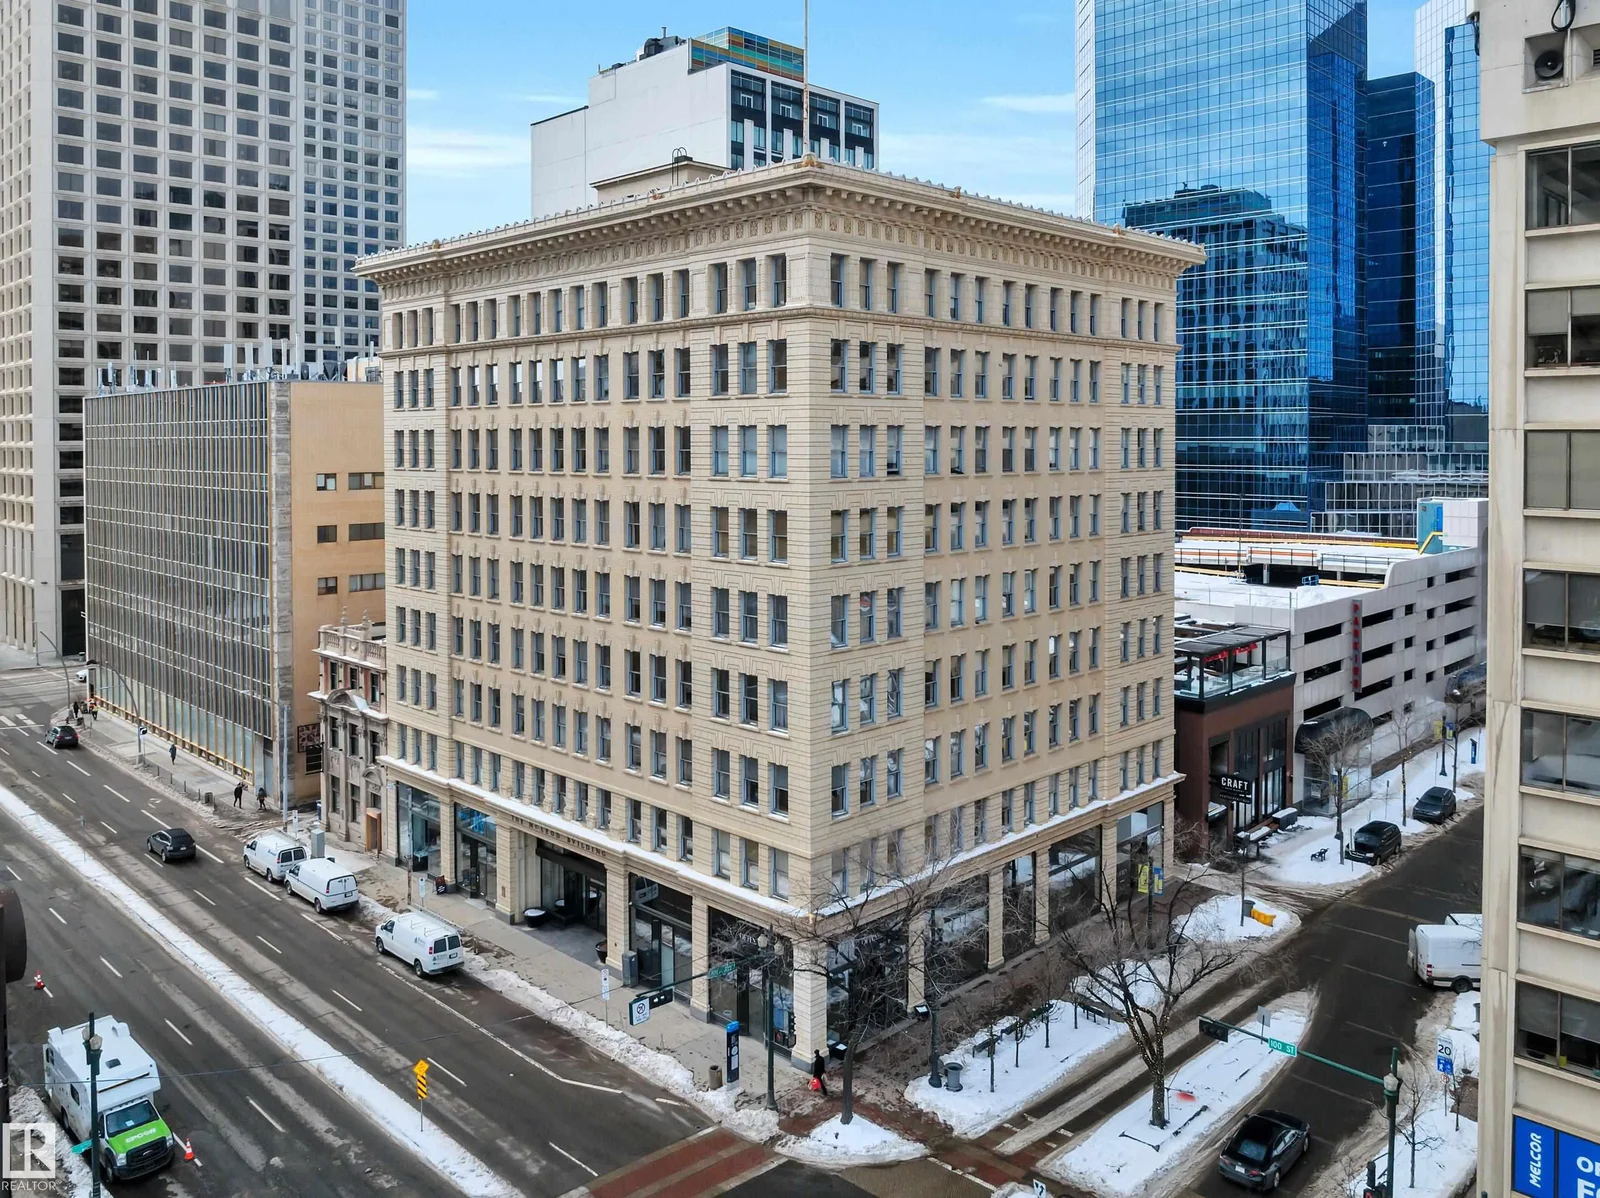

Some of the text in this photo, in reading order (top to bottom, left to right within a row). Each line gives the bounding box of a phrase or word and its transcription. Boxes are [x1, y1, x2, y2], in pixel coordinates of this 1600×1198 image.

[1221, 777, 1249, 790] CRAFT
[511, 814, 524, 825] THE
[1270, 1039, 1295, 1054] 100 ST
[1438, 1044, 1452, 1056] 20
[1529, 1132, 1542, 1189] MELCOR
